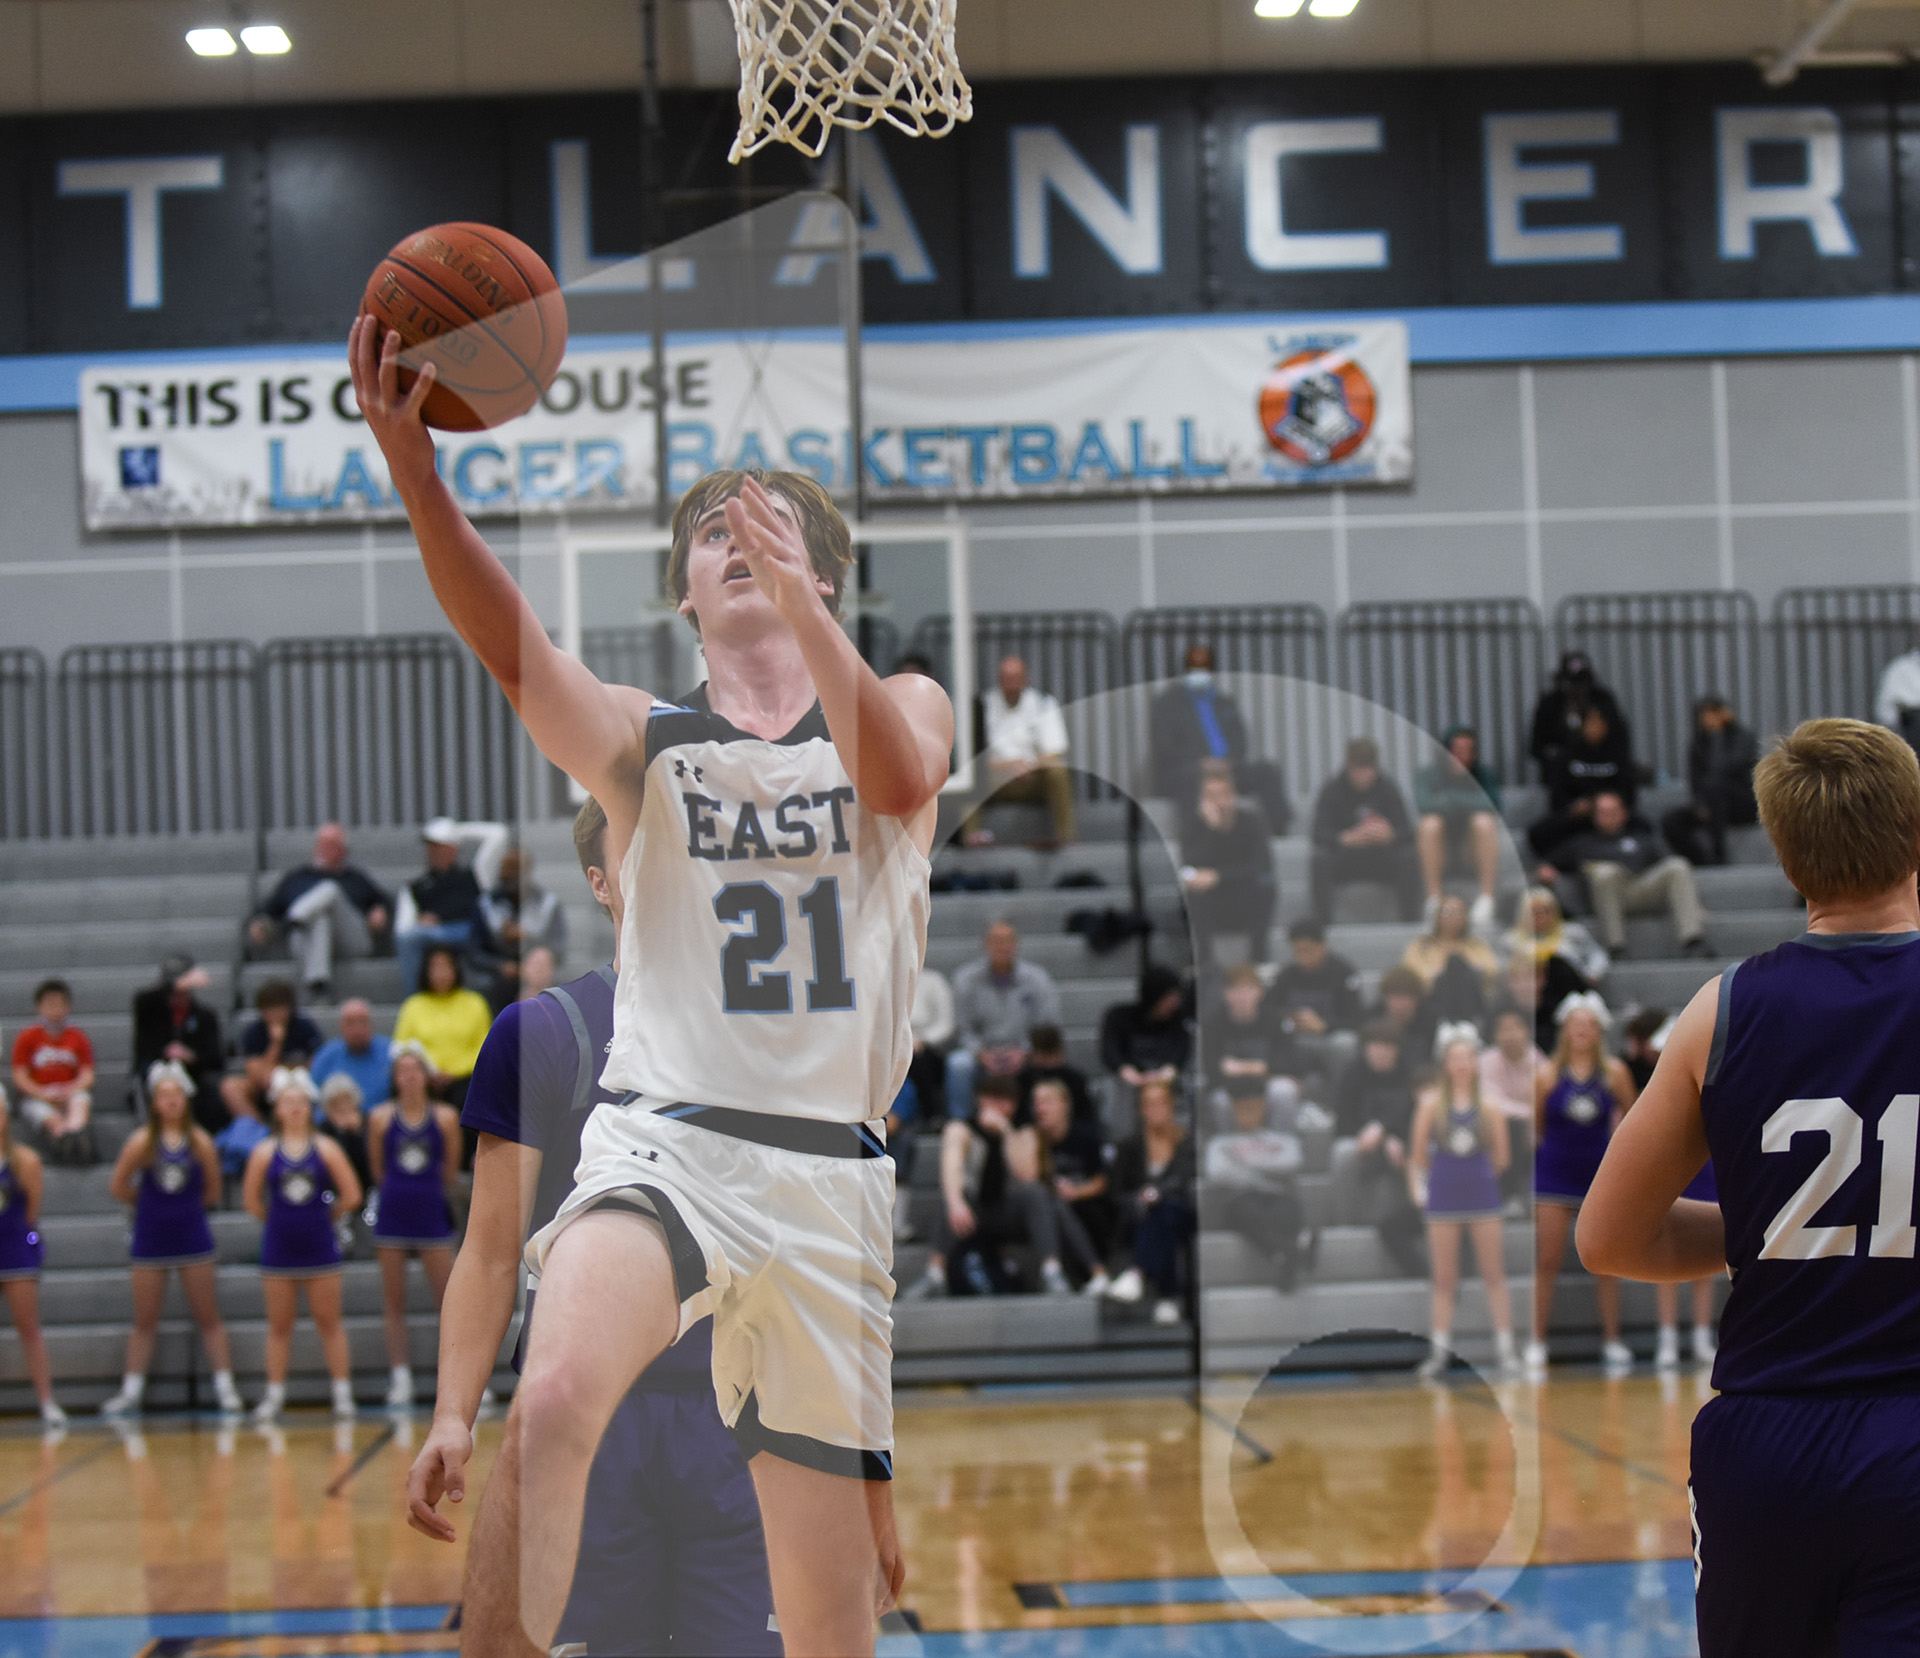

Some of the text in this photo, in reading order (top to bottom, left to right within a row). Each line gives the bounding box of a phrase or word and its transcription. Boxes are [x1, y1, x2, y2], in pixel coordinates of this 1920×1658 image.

[57, 106, 1859, 309] T LANCER
[95, 378, 239, 428] THIS
[259, 377, 311, 424] IS
[541, 361, 708, 415] OUSE
[665, 417, 1228, 496] BASKETBALL
[682, 786, 855, 861] EAST
[712, 876, 857, 1014] 21
[1757, 1094, 1920, 1260] 21
